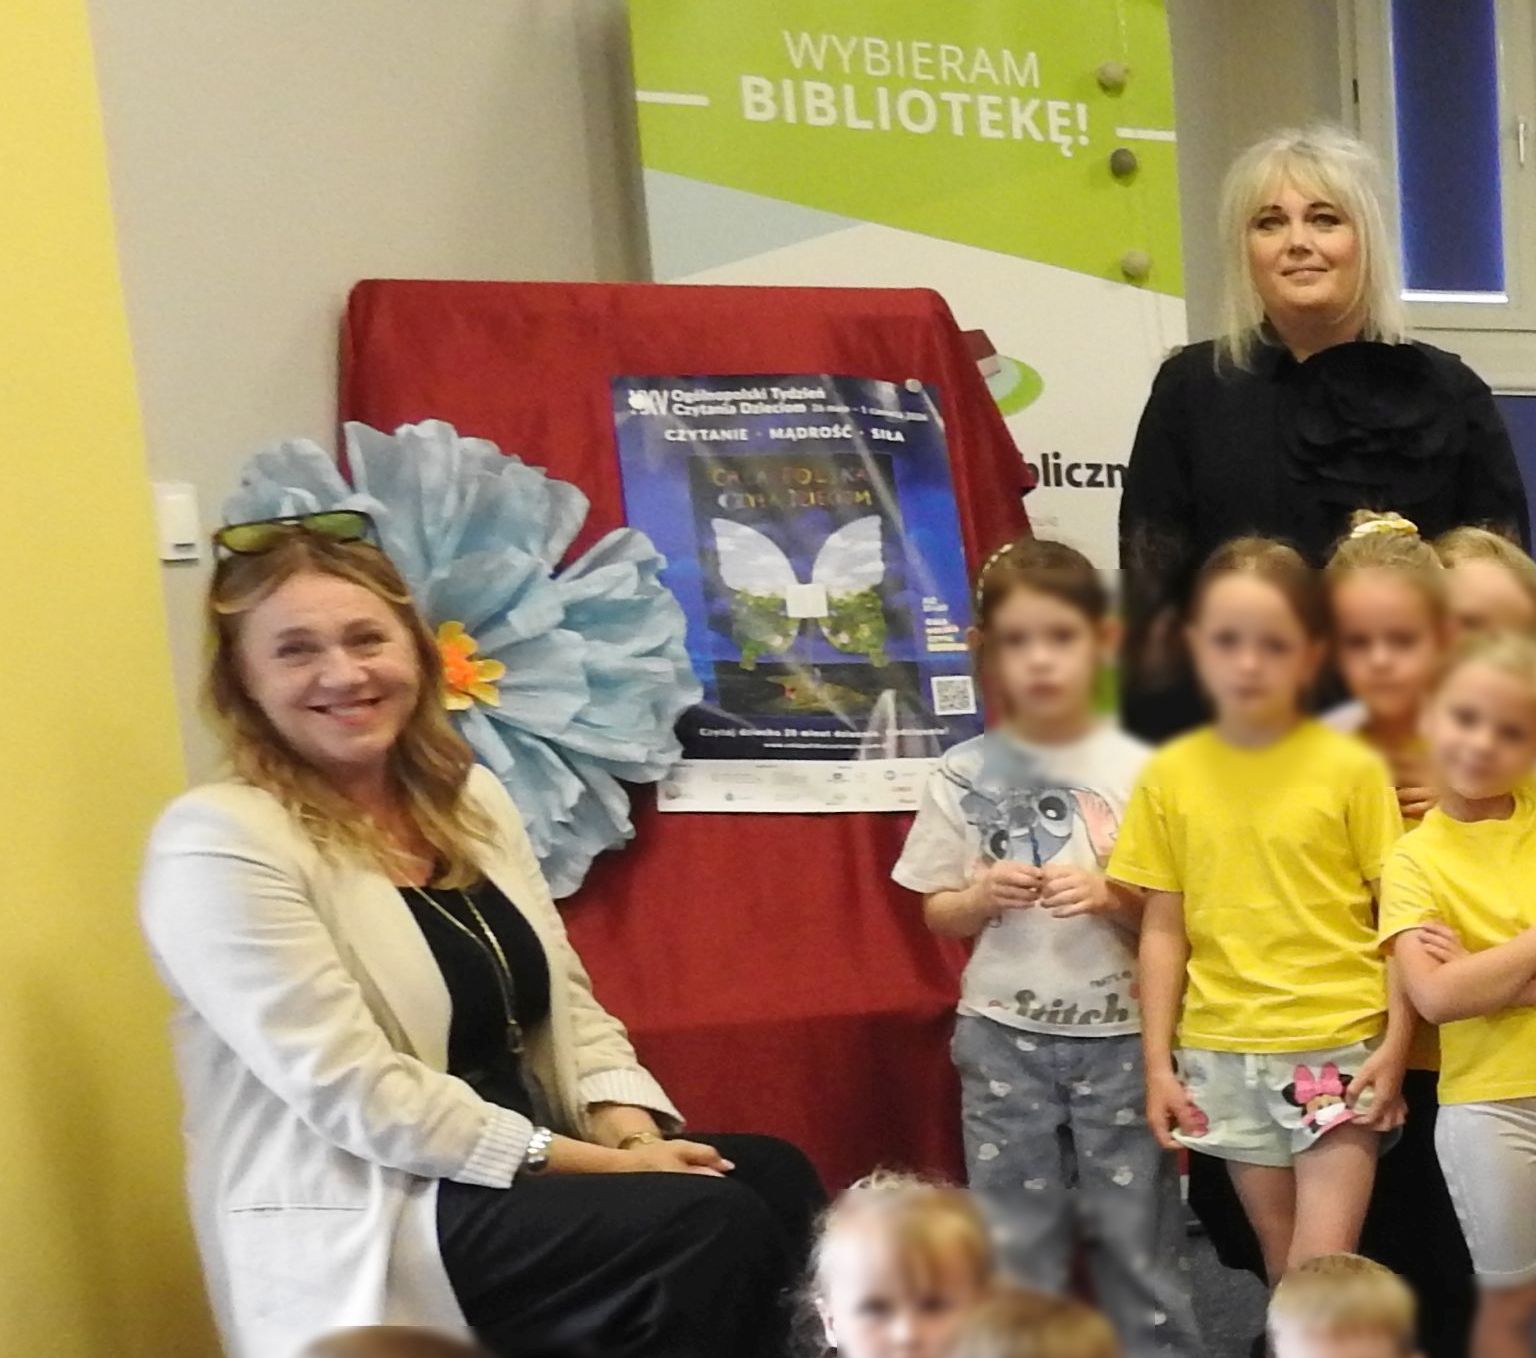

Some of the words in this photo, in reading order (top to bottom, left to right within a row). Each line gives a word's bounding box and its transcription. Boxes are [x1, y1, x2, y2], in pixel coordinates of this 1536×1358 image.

[783, 30, 1041, 89] WYBIERAM
[740, 75, 1090, 157] BIBLIOTEKĘ!
[664, 428, 749, 441] CZYTANIE
[769, 424, 853, 441] MĄDROŚĆ
[870, 427, 905, 442] SIŁA
[1026, 452, 1131, 488] liczn
